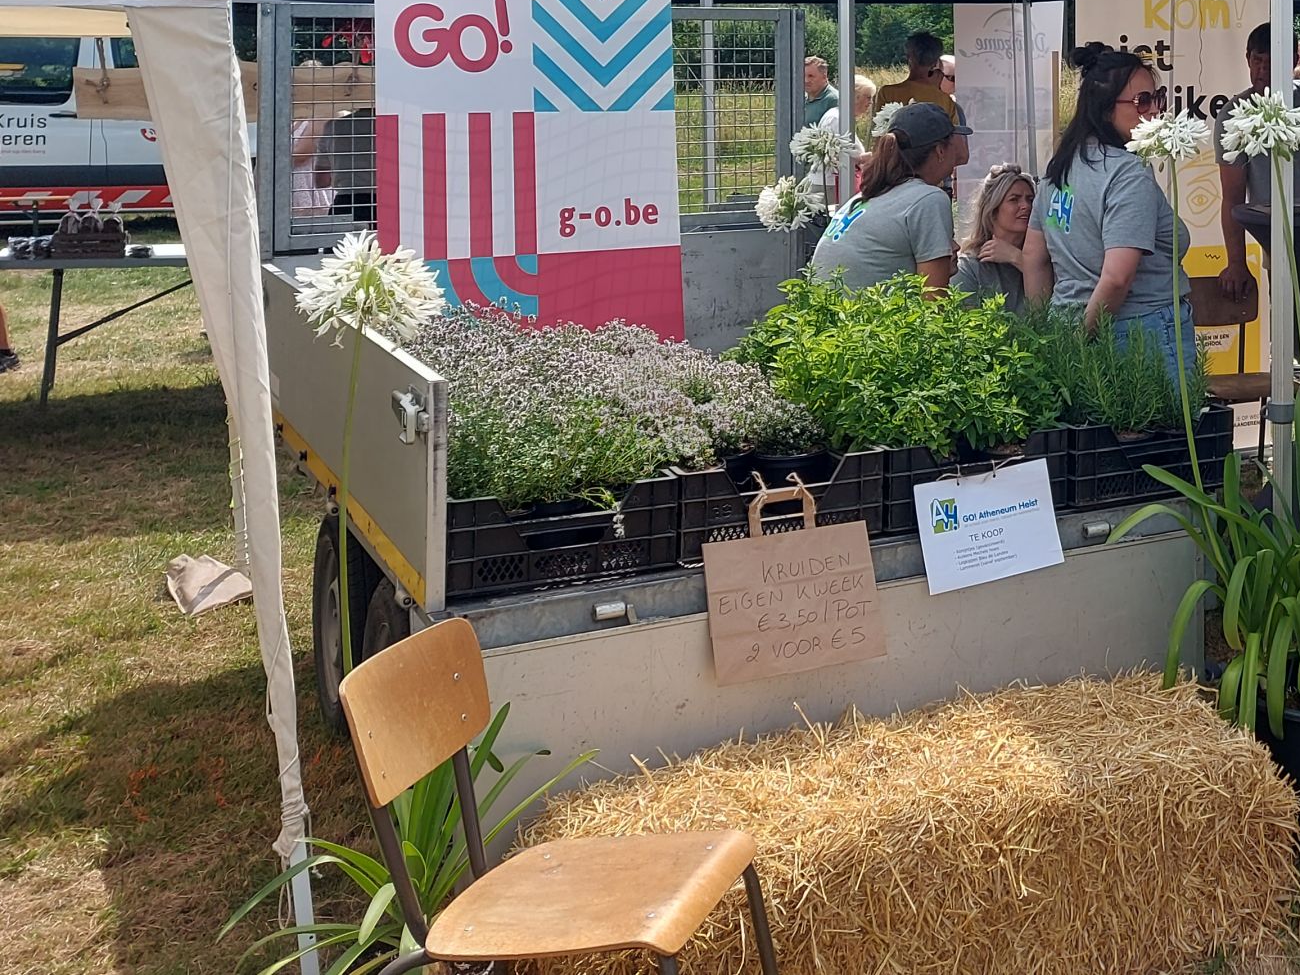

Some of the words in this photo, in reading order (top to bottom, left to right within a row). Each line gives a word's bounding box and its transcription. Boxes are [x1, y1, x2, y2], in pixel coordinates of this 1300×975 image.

[2, 134, 46, 145] eren
[559, 198, 659, 237] g-o.be
[978, 505, 1017, 520] Atheneum
[1018, 498, 1038, 511] Heist
[969, 534, 979, 542] TE
[981, 527, 1005, 540] KOOP
[762, 553, 850, 583] KRUIDEN
[745, 642, 760, 663] 2
[772, 636, 822, 659] VOOR
